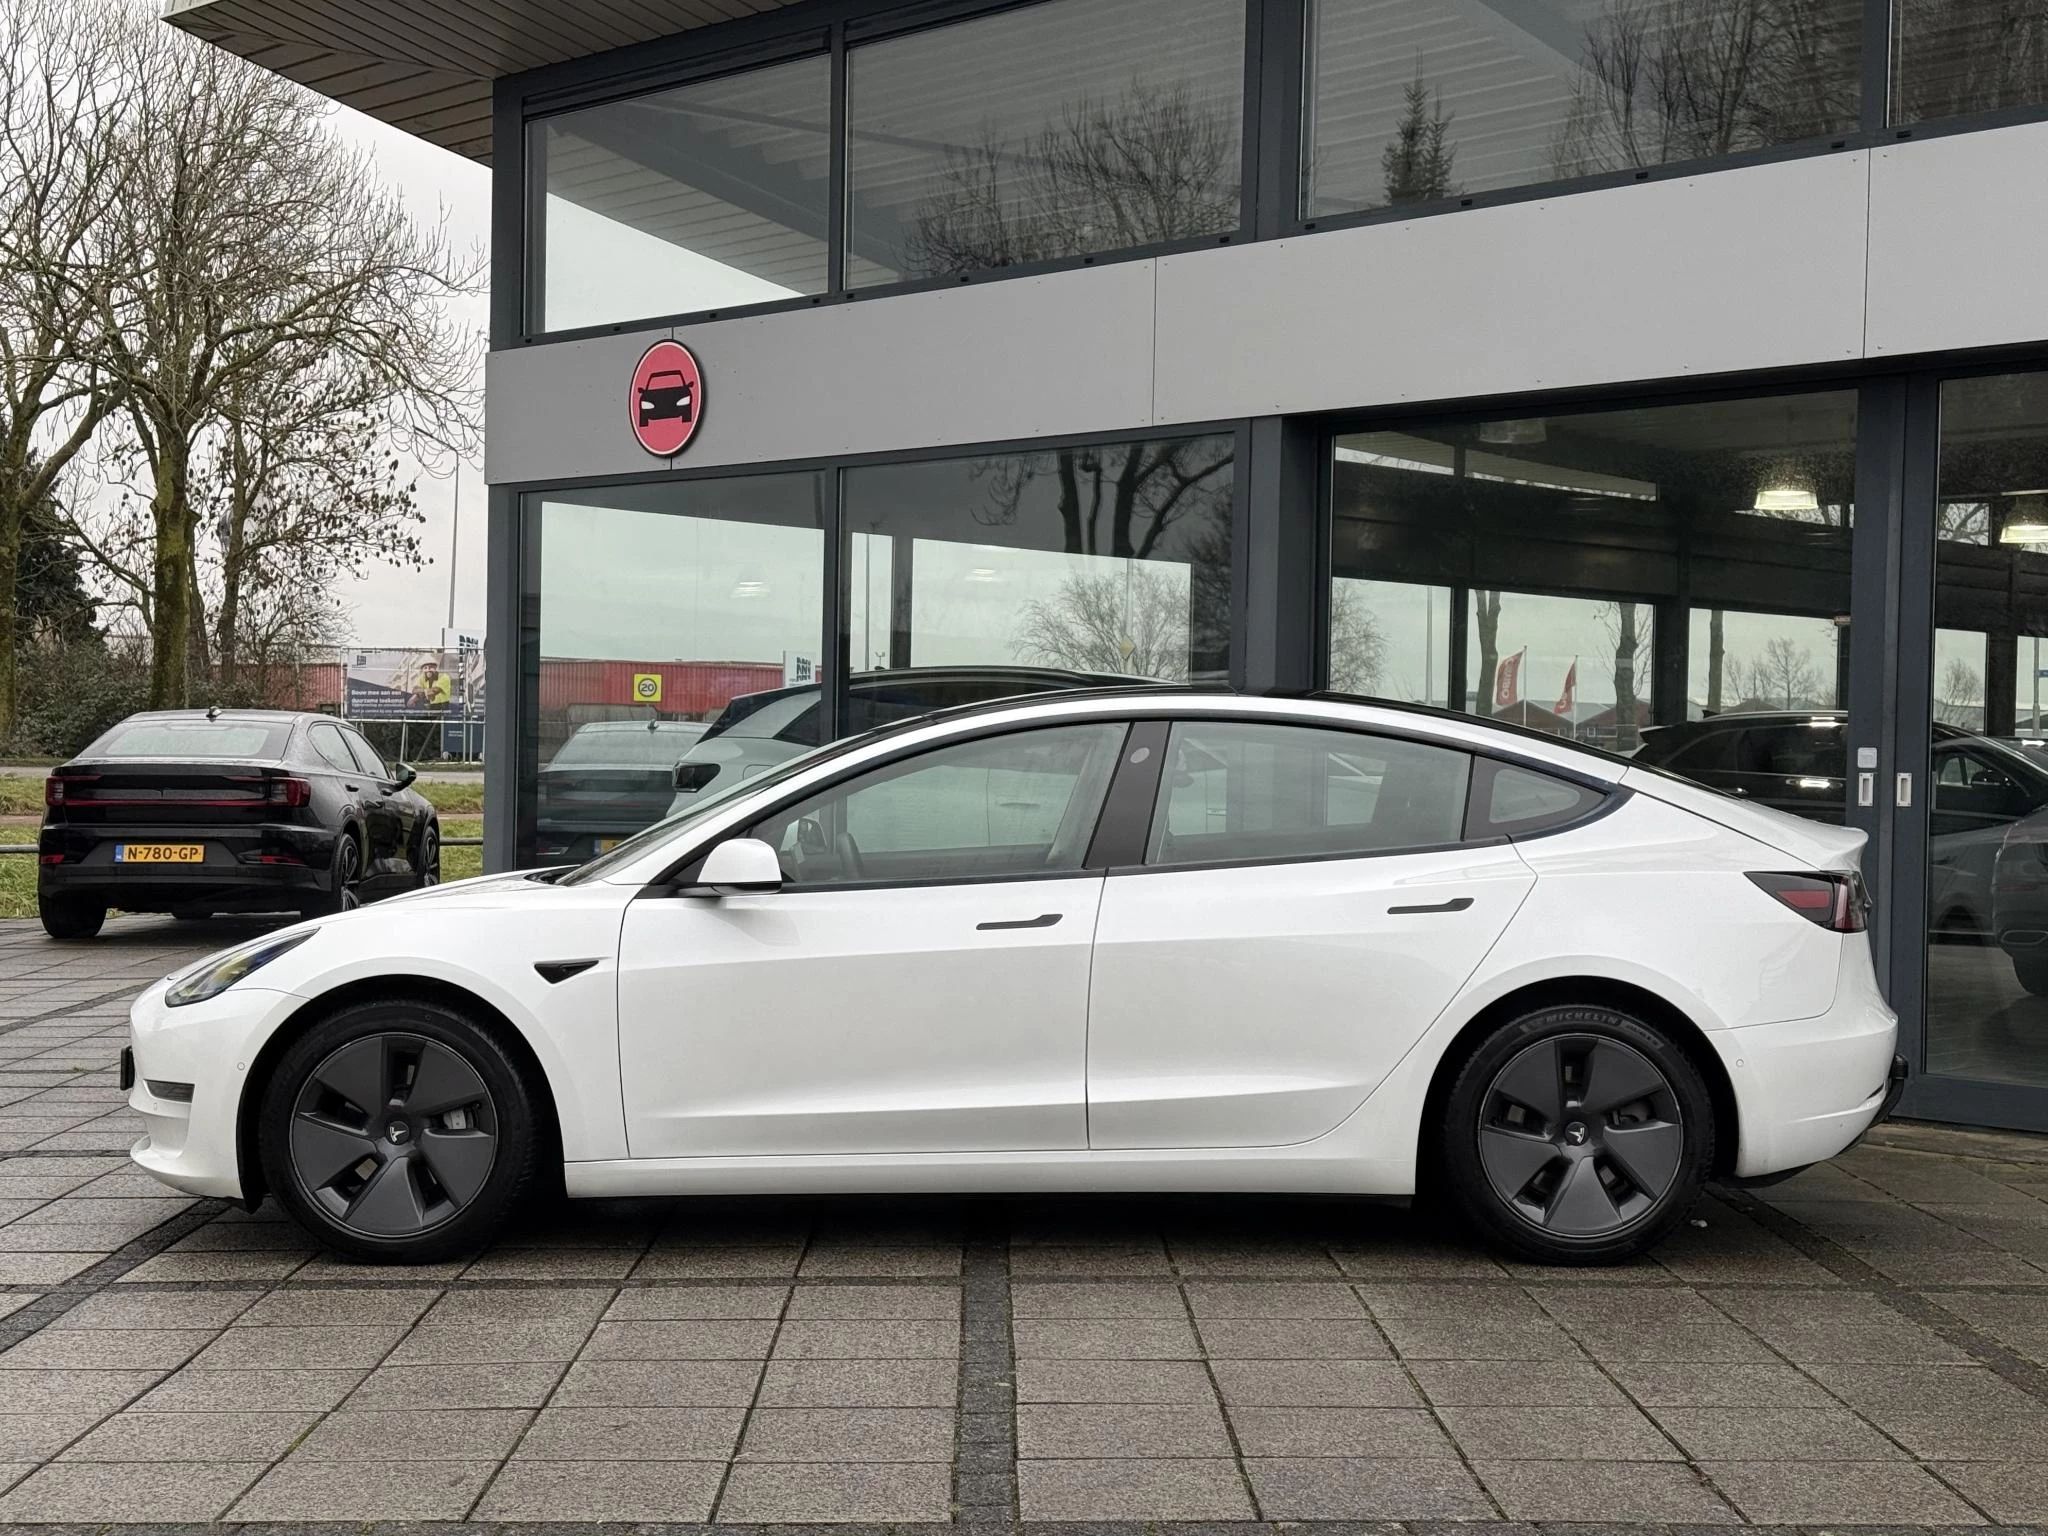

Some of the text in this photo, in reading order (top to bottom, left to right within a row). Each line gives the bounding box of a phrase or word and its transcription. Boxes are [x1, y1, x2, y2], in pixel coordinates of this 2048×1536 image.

[641, 683, 654, 692] 20
[127, 847, 199, 860] N-780-GP
[1546, 1012, 1618, 1024] MICHELIN
